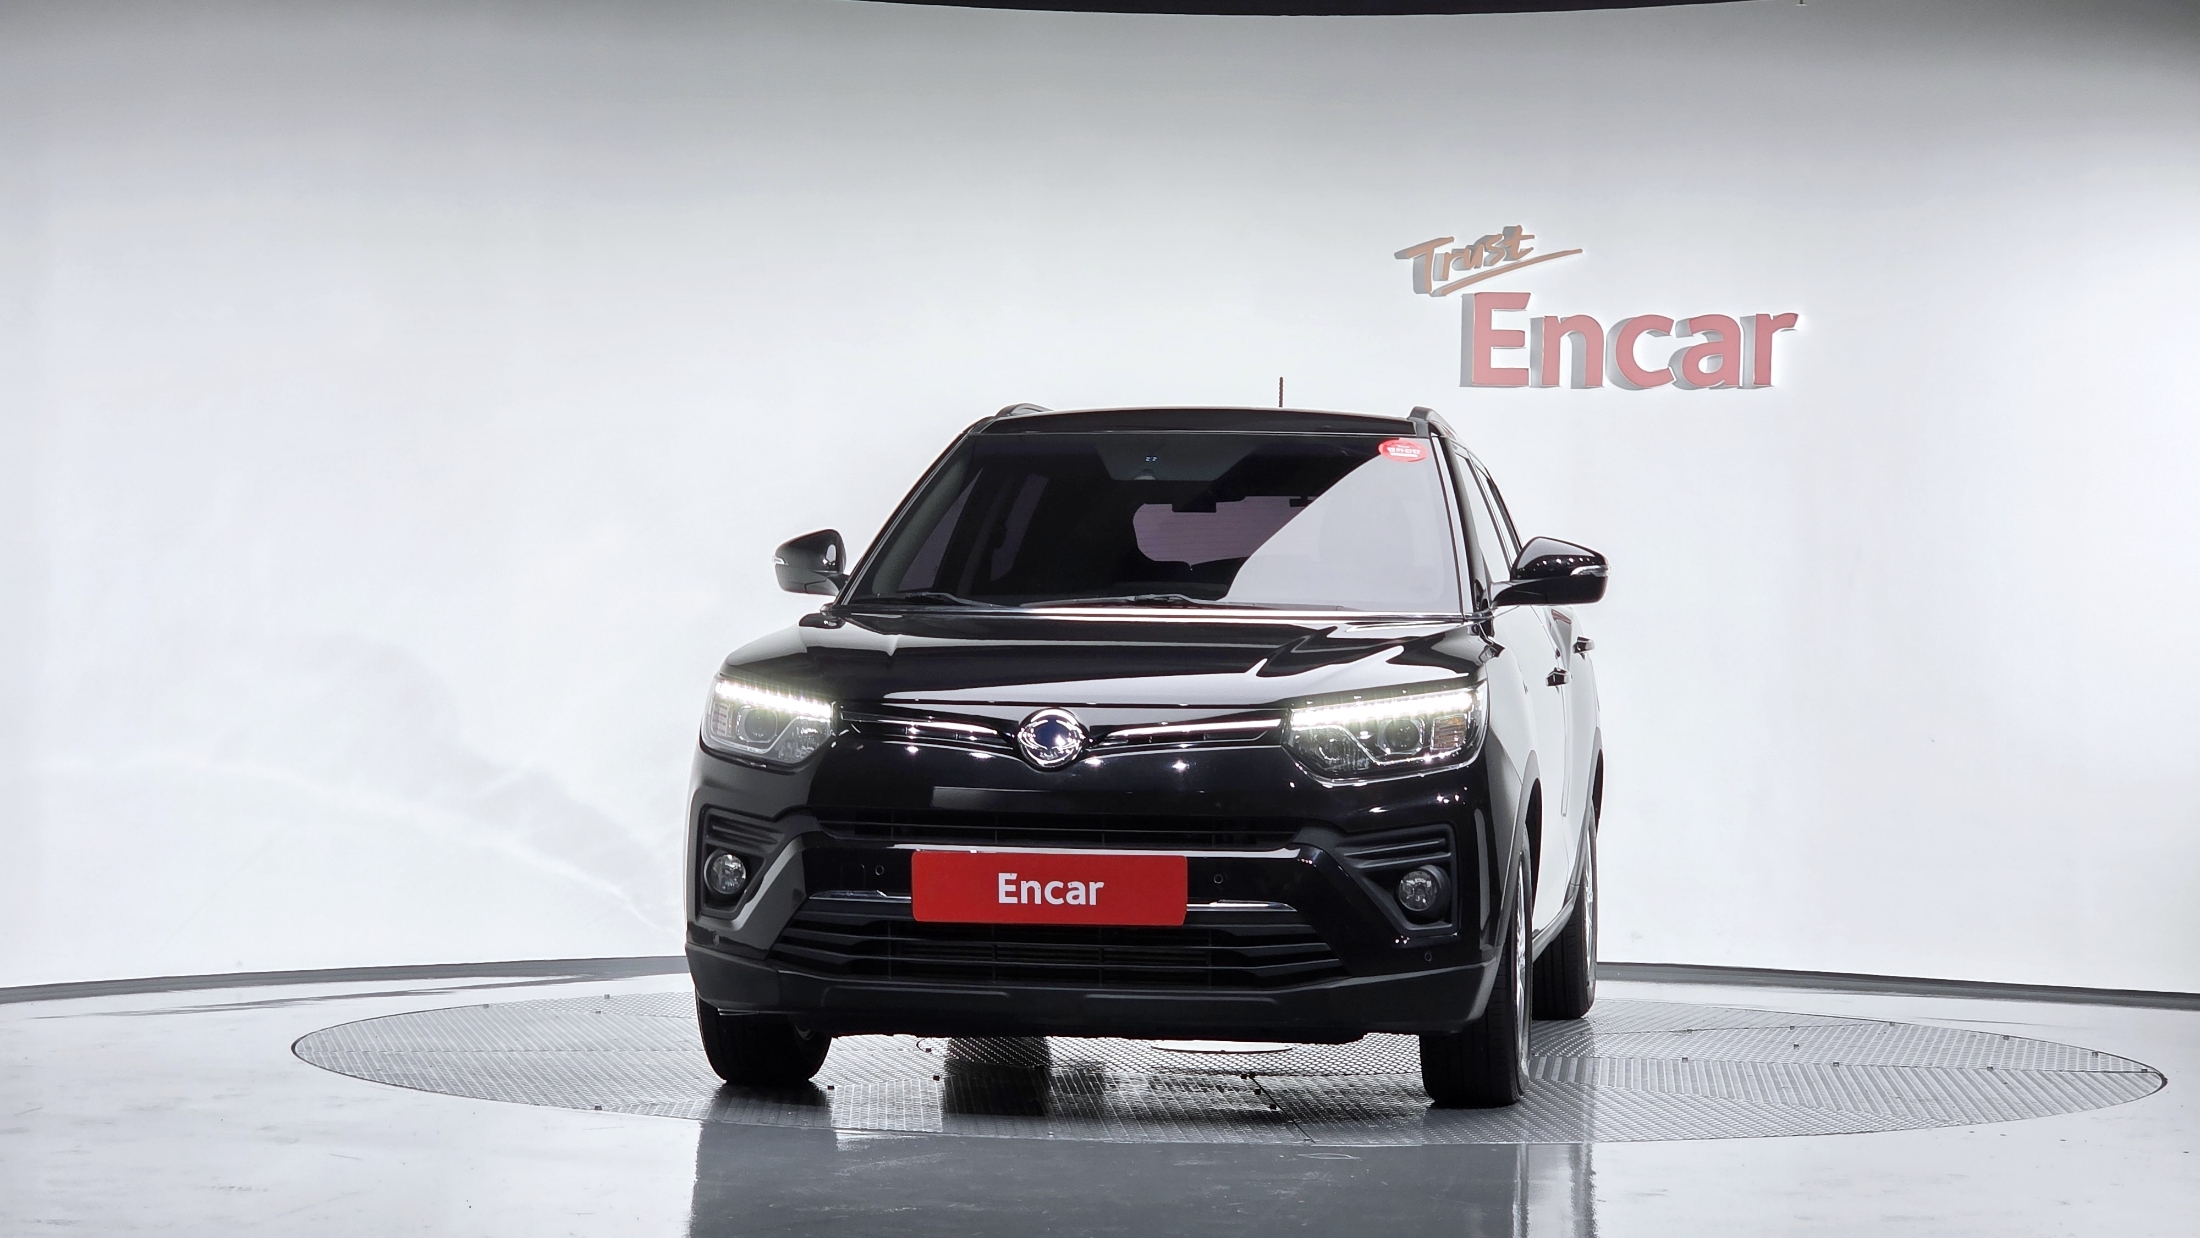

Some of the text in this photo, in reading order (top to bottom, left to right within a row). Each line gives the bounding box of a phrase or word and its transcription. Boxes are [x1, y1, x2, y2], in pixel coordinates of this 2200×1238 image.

[1395, 225, 1535, 294] Trust
[1461, 291, 1799, 389] Encar
[997, 872, 1105, 906] Encar
